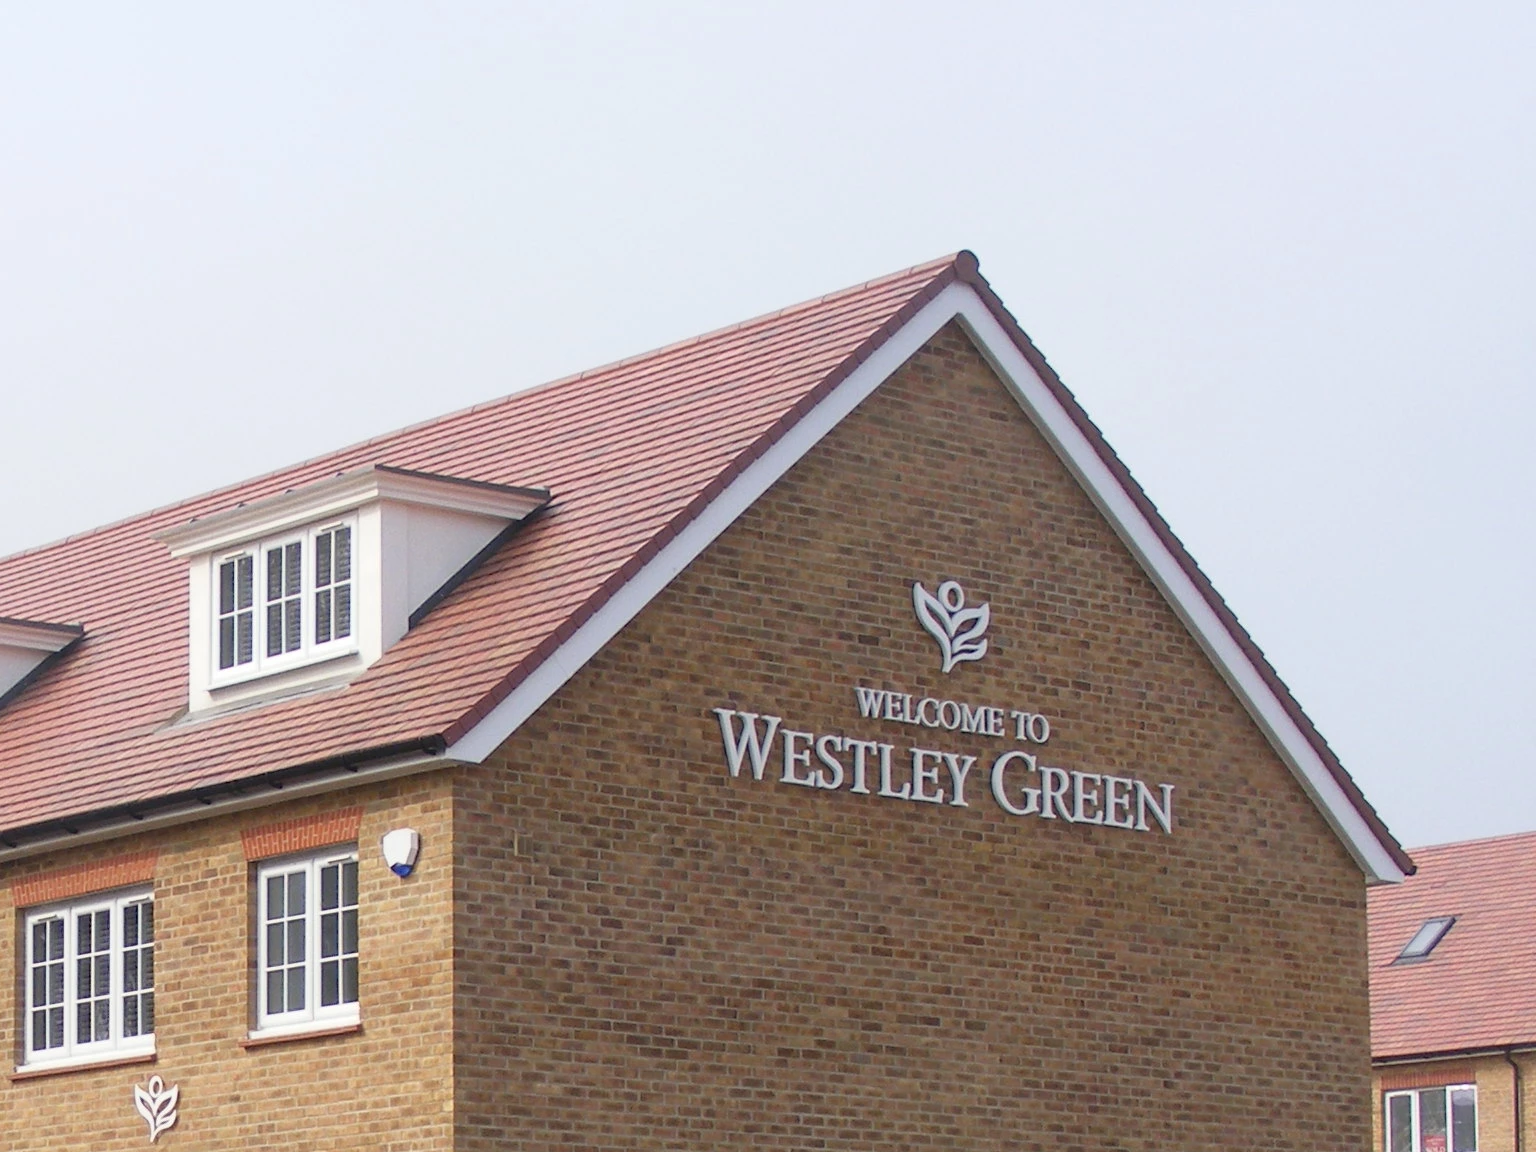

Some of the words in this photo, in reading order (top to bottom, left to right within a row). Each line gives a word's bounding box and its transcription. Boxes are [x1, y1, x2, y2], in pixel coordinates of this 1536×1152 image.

[854, 687, 1005, 737] WELCOME
[1011, 710, 1050, 744] TO
[713, 708, 977, 807] WESTLEY
[991, 750, 1175, 834] GREEN
